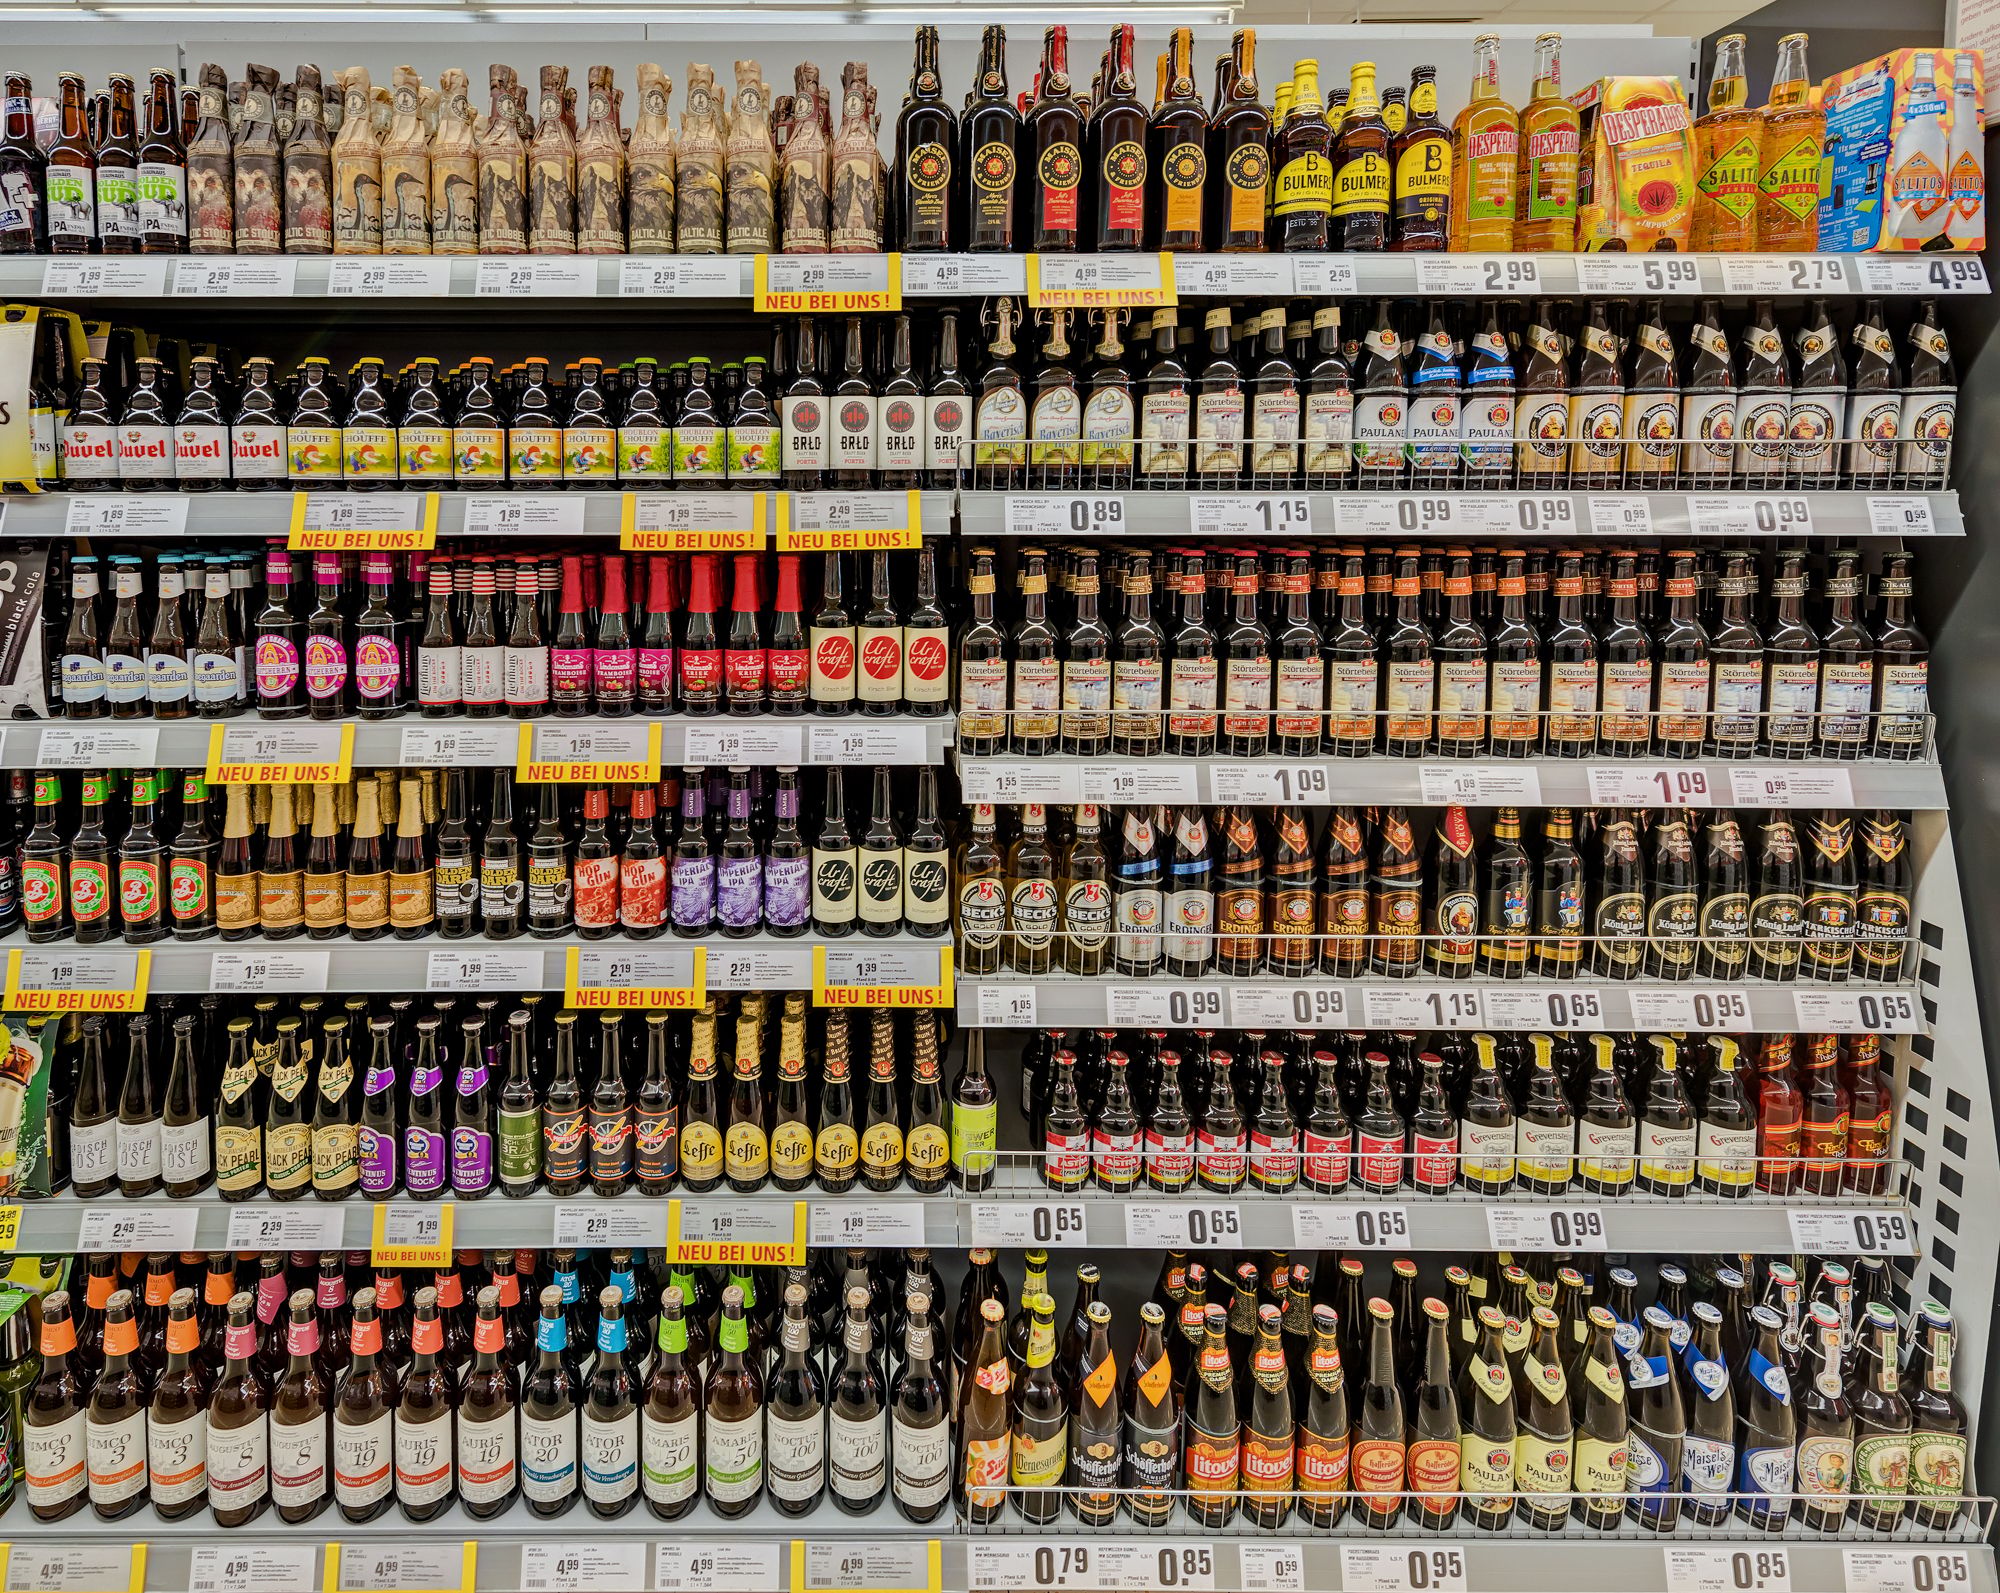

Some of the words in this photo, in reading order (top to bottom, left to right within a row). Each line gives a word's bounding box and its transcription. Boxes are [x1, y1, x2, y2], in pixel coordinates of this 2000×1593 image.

[1604, 103, 1688, 144] DESPERADOS
[1631, 160, 1672, 173] TEQUILA
[1284, 174, 1331, 190] BULMERS
[1408, 174, 1449, 188] BULMERS
[1894, 176, 1942, 190] SALITOS
[1949, 177, 1983, 190] SALITOS
[706, 229, 722, 240] ALE
[754, 227, 769, 239] ALE
[1484, 261, 1536, 290] 2.99
[1644, 261, 1696, 290] 5.99
[1789, 261, 1842, 289] 2.79
[1930, 261, 1982, 289] 4.99
[766, 294, 802, 309] NEU
[809, 293, 837, 308] BEI
[623, 435, 660, 443] CHOUFFE
[679, 435, 716, 443] CHOUFFE
[1361, 428, 1405, 438] PAULANE
[64, 439, 114, 458] Duvel
[1071, 501, 1121, 531] 0.89
[1256, 501, 1307, 530] 1.15
[1398, 500, 1450, 530] 0.99
[1518, 500, 1570, 530] 0.99
[1755, 501, 1808, 531] 0.99
[300, 533, 338, 548] NEU
[343, 533, 372, 548] BEI
[631, 533, 668, 548] NEU
[675, 533, 703, 548] BEI
[788, 533, 824, 549] NEU
[831, 532, 858, 548] BEI
[5, 599, 28, 631] black
[24, 571, 41, 595] cola
[820, 640, 842, 656] Ur
[865, 640, 887, 656] Ur
[911, 641, 933, 656] Ur
[218, 767, 254, 782] NEU
[260, 766, 288, 781] BEI
[1274, 770, 1325, 800] 1.09
[1654, 772, 1706, 803] 1.09
[436, 873, 472, 885] DARK
[529, 872, 566, 885] DARK
[579, 864, 601, 877] HOP
[587, 871, 611, 887] GUN
[624, 865, 645, 877] HOP
[632, 872, 655, 887] GUN
[729, 877, 745, 886] IPA
[773, 877, 789, 886] IPA
[961, 905, 1005, 920] BECK'S
[1013, 905, 1058, 920] BECK'S
[1067, 907, 1111, 921] BECK'S
[1220, 919, 1264, 934] ERDINGER
[1170, 992, 1220, 1023] 0.99
[1293, 991, 1343, 1023] 0.99
[1426, 994, 1477, 1025] 1.15
[1548, 994, 1598, 1026] 0.65
[1698, 994, 1749, 1027] 0.95
[1859, 996, 1911, 1028] 0.65
[230, 1149, 259, 1167] PEARL
[683, 1139, 716, 1163] Leffe
[775, 1139, 807, 1163] Leffe
[820, 1141, 853, 1164] Leffe
[911, 1141, 944, 1164] Leffe
[1061, 1158, 1089, 1168] ASTRA
[1104, 1158, 1138, 1168] ASTRA
[1209, 1159, 1241, 1168] ASTRA
[1034, 1208, 1082, 1241] 0.65
[1189, 1210, 1238, 1244] 0.65
[1356, 1211, 1405, 1245] 0.65
[1854, 1216, 1906, 1250] 0.59
[50, 1446, 66, 1467] 3
[110, 1444, 126, 1466] 3
[238, 1447, 253, 1468] 8
[354, 1448, 376, 1468] 19
[480, 1445, 501, 1464] 19
[536, 1447, 559, 1462] 20
[598, 1448, 621, 1463] 20
[734, 1441, 757, 1467] 50
[790, 1441, 817, 1459] 100
[917, 1446, 942, 1466] 100
[1193, 1452, 1239, 1477] Litovel
[1246, 1452, 1293, 1477] Litovel
[1304, 1452, 1349, 1478] Litovel
[1467, 1461, 1513, 1481] PAULAN
[1036, 1547, 1088, 1584] 0.79
[1159, 1549, 1211, 1585] 0.85
[1409, 1551, 1461, 1588] 0.95
[1733, 1553, 1785, 1588] 0.85
[1913, 1556, 1966, 1591] 0.85
